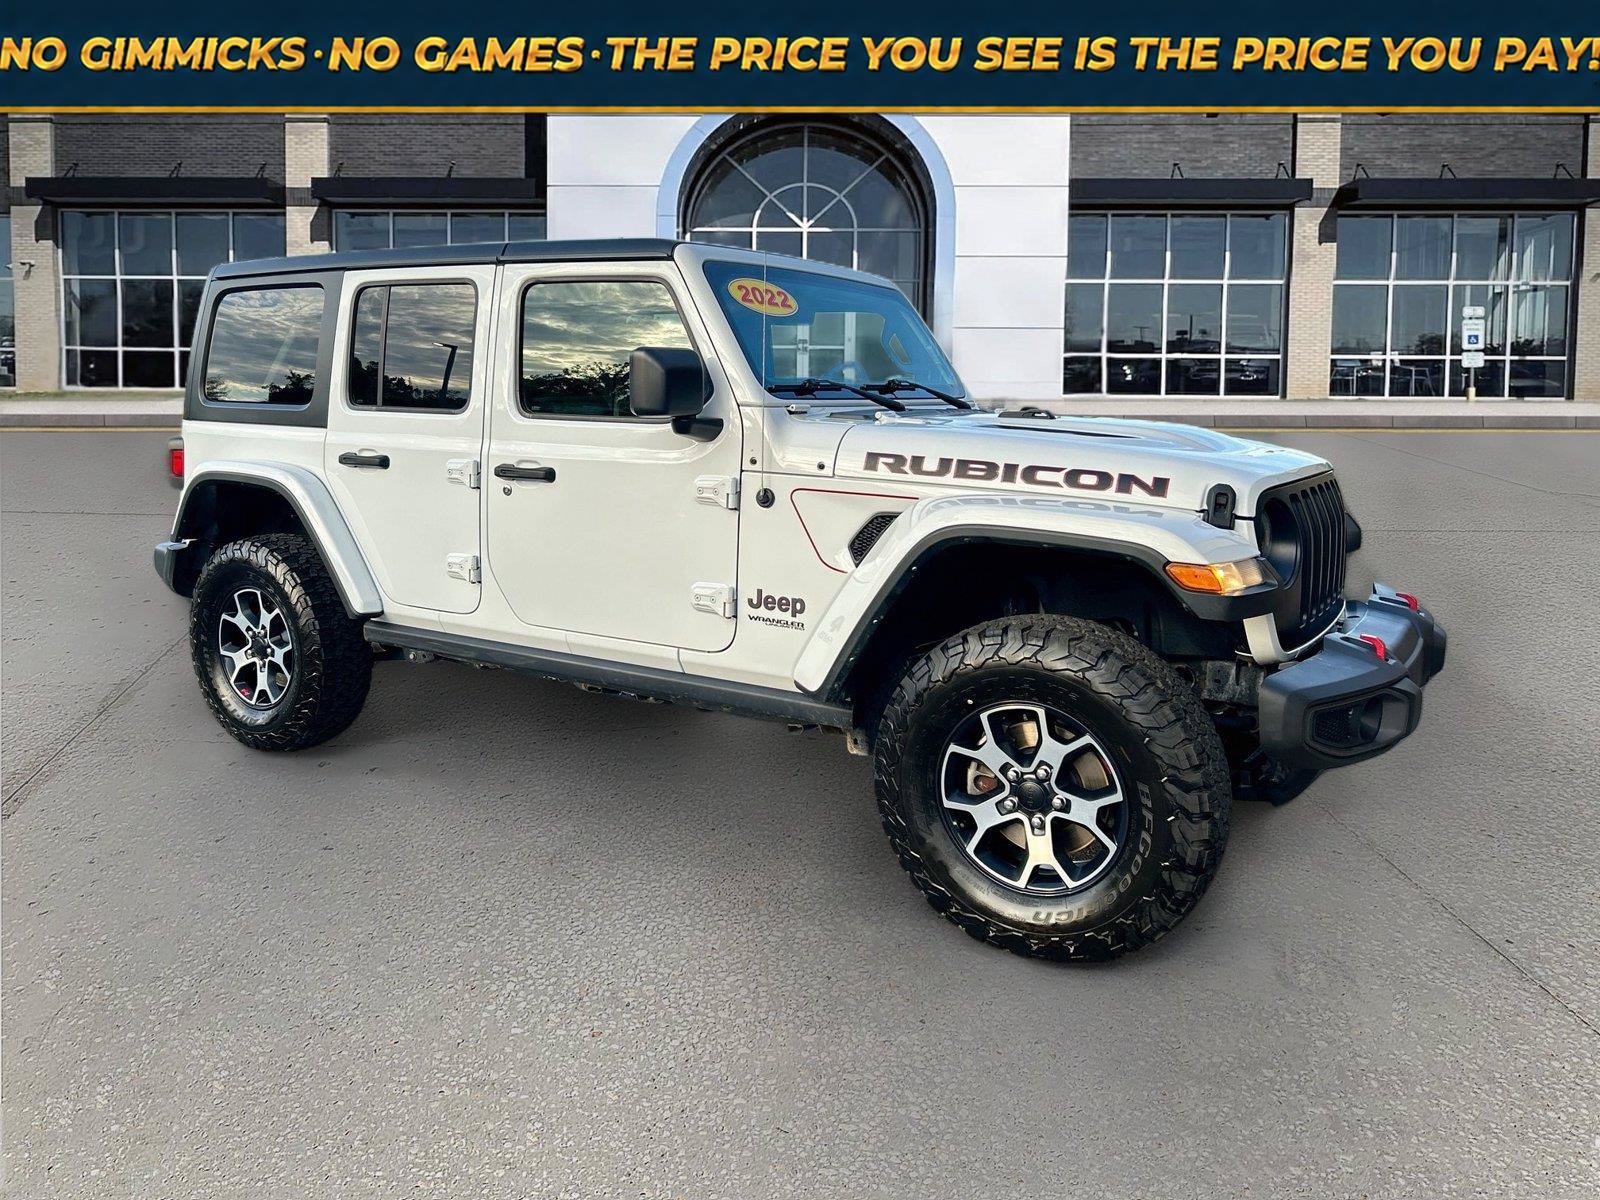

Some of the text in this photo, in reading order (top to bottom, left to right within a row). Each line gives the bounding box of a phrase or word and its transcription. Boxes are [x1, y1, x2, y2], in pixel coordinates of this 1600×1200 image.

[737, 284, 792, 309] 2022
[862, 451, 1171, 499] RUBICON
[747, 588, 806, 618] Jeep
[747, 614, 805, 629] WRANGLER
